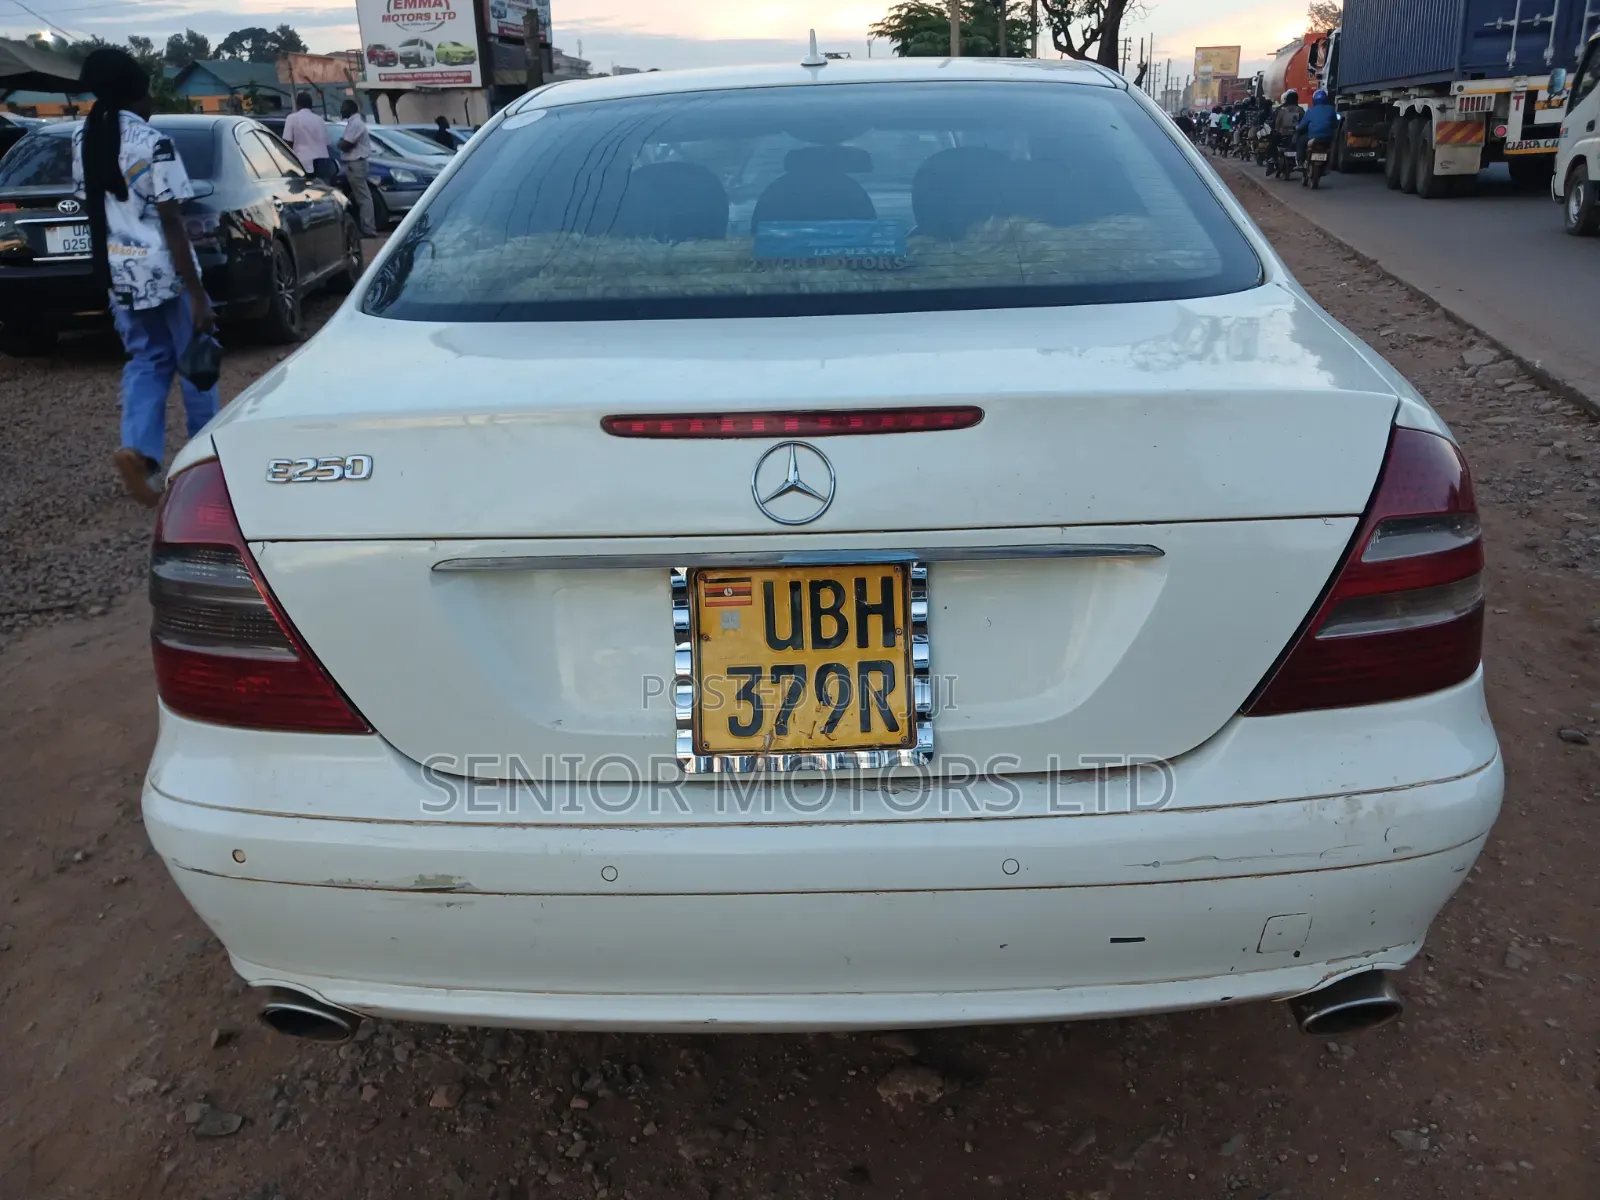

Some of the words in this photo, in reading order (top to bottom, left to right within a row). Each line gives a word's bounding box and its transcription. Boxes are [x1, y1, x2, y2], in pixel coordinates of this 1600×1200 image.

[382, 12, 431, 23] MOTORS
[435, 11, 457, 20] LTD
[393, 0, 443, 10] EMMA
[266, 453, 374, 483] E250
[763, 575, 897, 651] UBH
[726, 659, 900, 738] 379R
